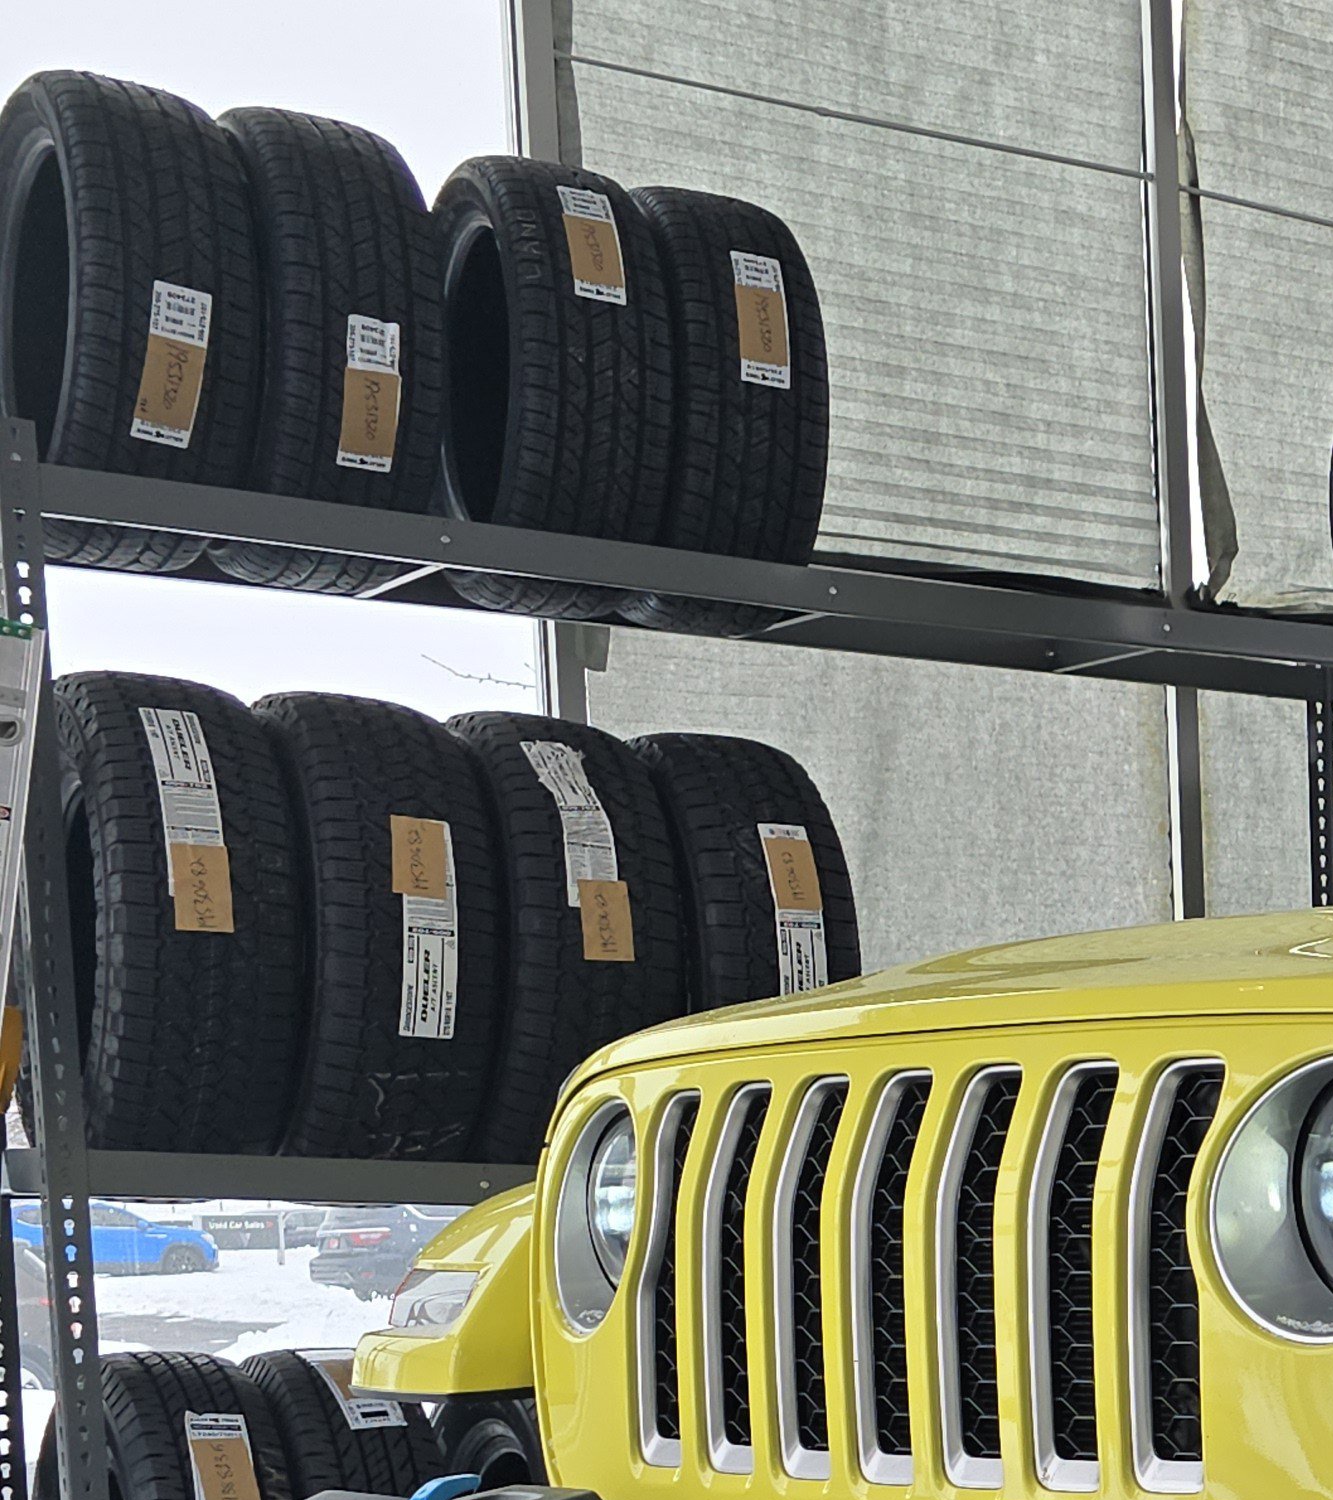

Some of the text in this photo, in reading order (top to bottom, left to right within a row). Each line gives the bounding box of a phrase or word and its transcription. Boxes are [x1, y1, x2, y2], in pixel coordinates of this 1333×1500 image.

[171, 718, 193, 771] DUELER
[420, 949, 431, 1023] DUELER
[229, 1220, 243, 1229] Car
